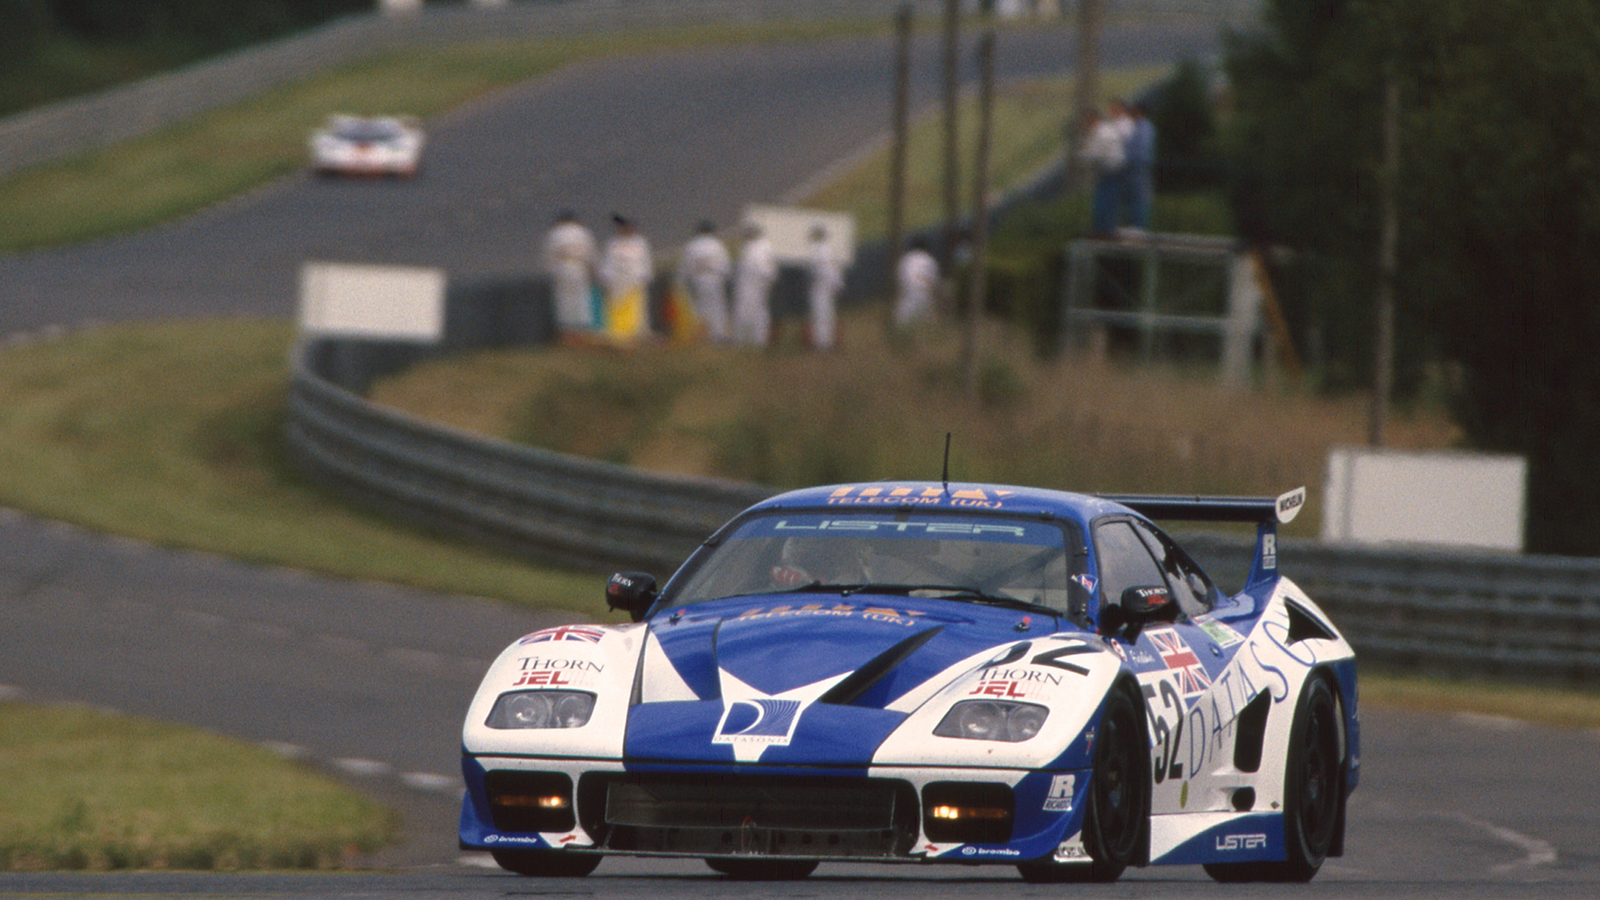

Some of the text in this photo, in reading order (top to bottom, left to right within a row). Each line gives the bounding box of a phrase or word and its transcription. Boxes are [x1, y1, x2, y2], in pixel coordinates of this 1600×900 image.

[826, 497, 1003, 509] TELECOM (UK)
[774, 519, 1026, 537] LISTER
[862, 613, 915, 627] (UK)
[517, 656, 605, 673] THORN
[979, 667, 1064, 687] THORN
[1141, 678, 1184, 785] 52
[713, 736, 789, 744] DATASONIX
[498, 835, 538, 844] brembo
[1215, 833, 1267, 851] LISTER
[977, 847, 1021, 856] brembo
